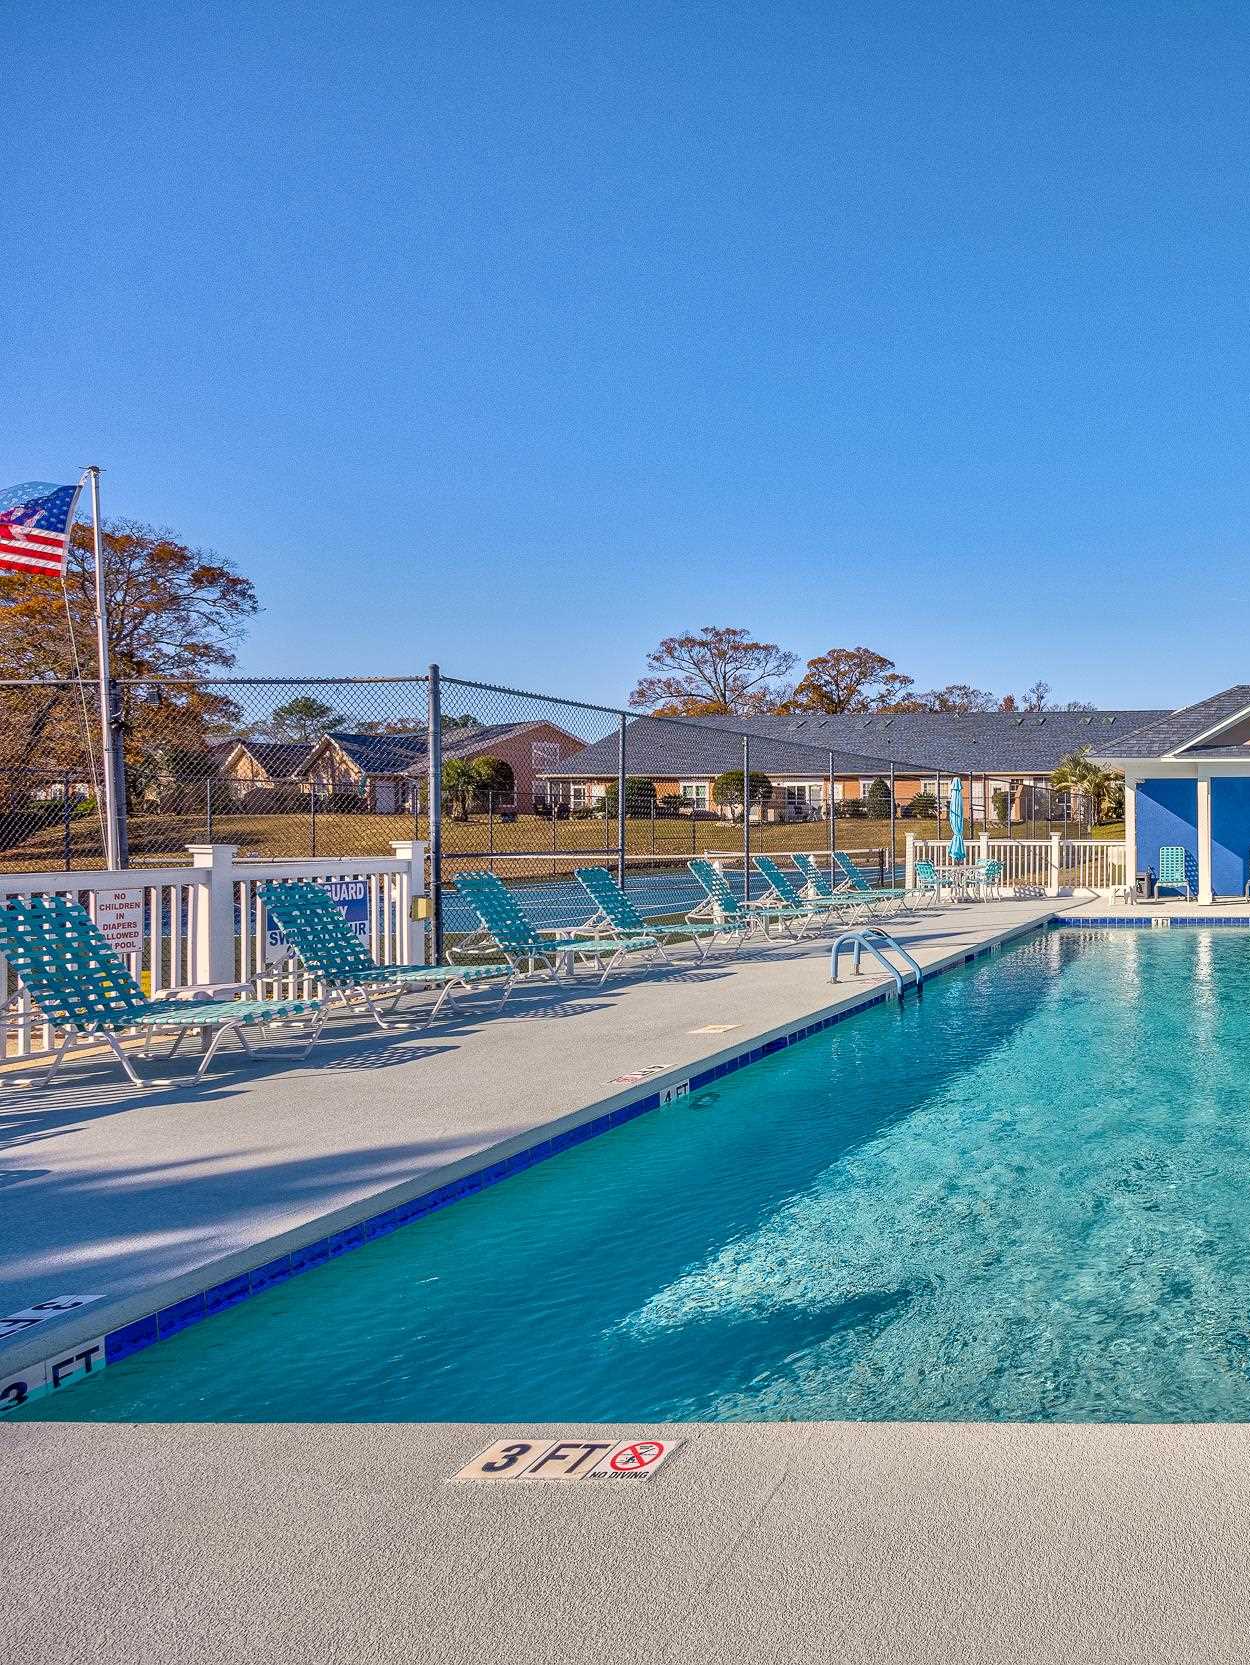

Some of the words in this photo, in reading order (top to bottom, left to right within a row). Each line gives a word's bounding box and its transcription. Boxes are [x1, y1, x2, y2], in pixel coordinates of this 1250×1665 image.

[114, 892, 126, 900] NO
[99, 902, 140, 911] CHILDREN
[116, 912, 125, 920] IN
[102, 921, 138, 931] DIAPERS
[106, 932, 140, 941] LLOWED
[114, 941, 137, 949] POOL
[663, 1089, 673, 1103] 4
[676, 1082, 689, 1097] FT
[0, 1381, 29, 1412] 3
[51, 1344, 100, 1389] FT
[481, 1443, 533, 1473] 3
[528, 1443, 612, 1474] FT
[588, 1471, 608, 1479] NO
[608, 1471, 650, 1479] DIVING
